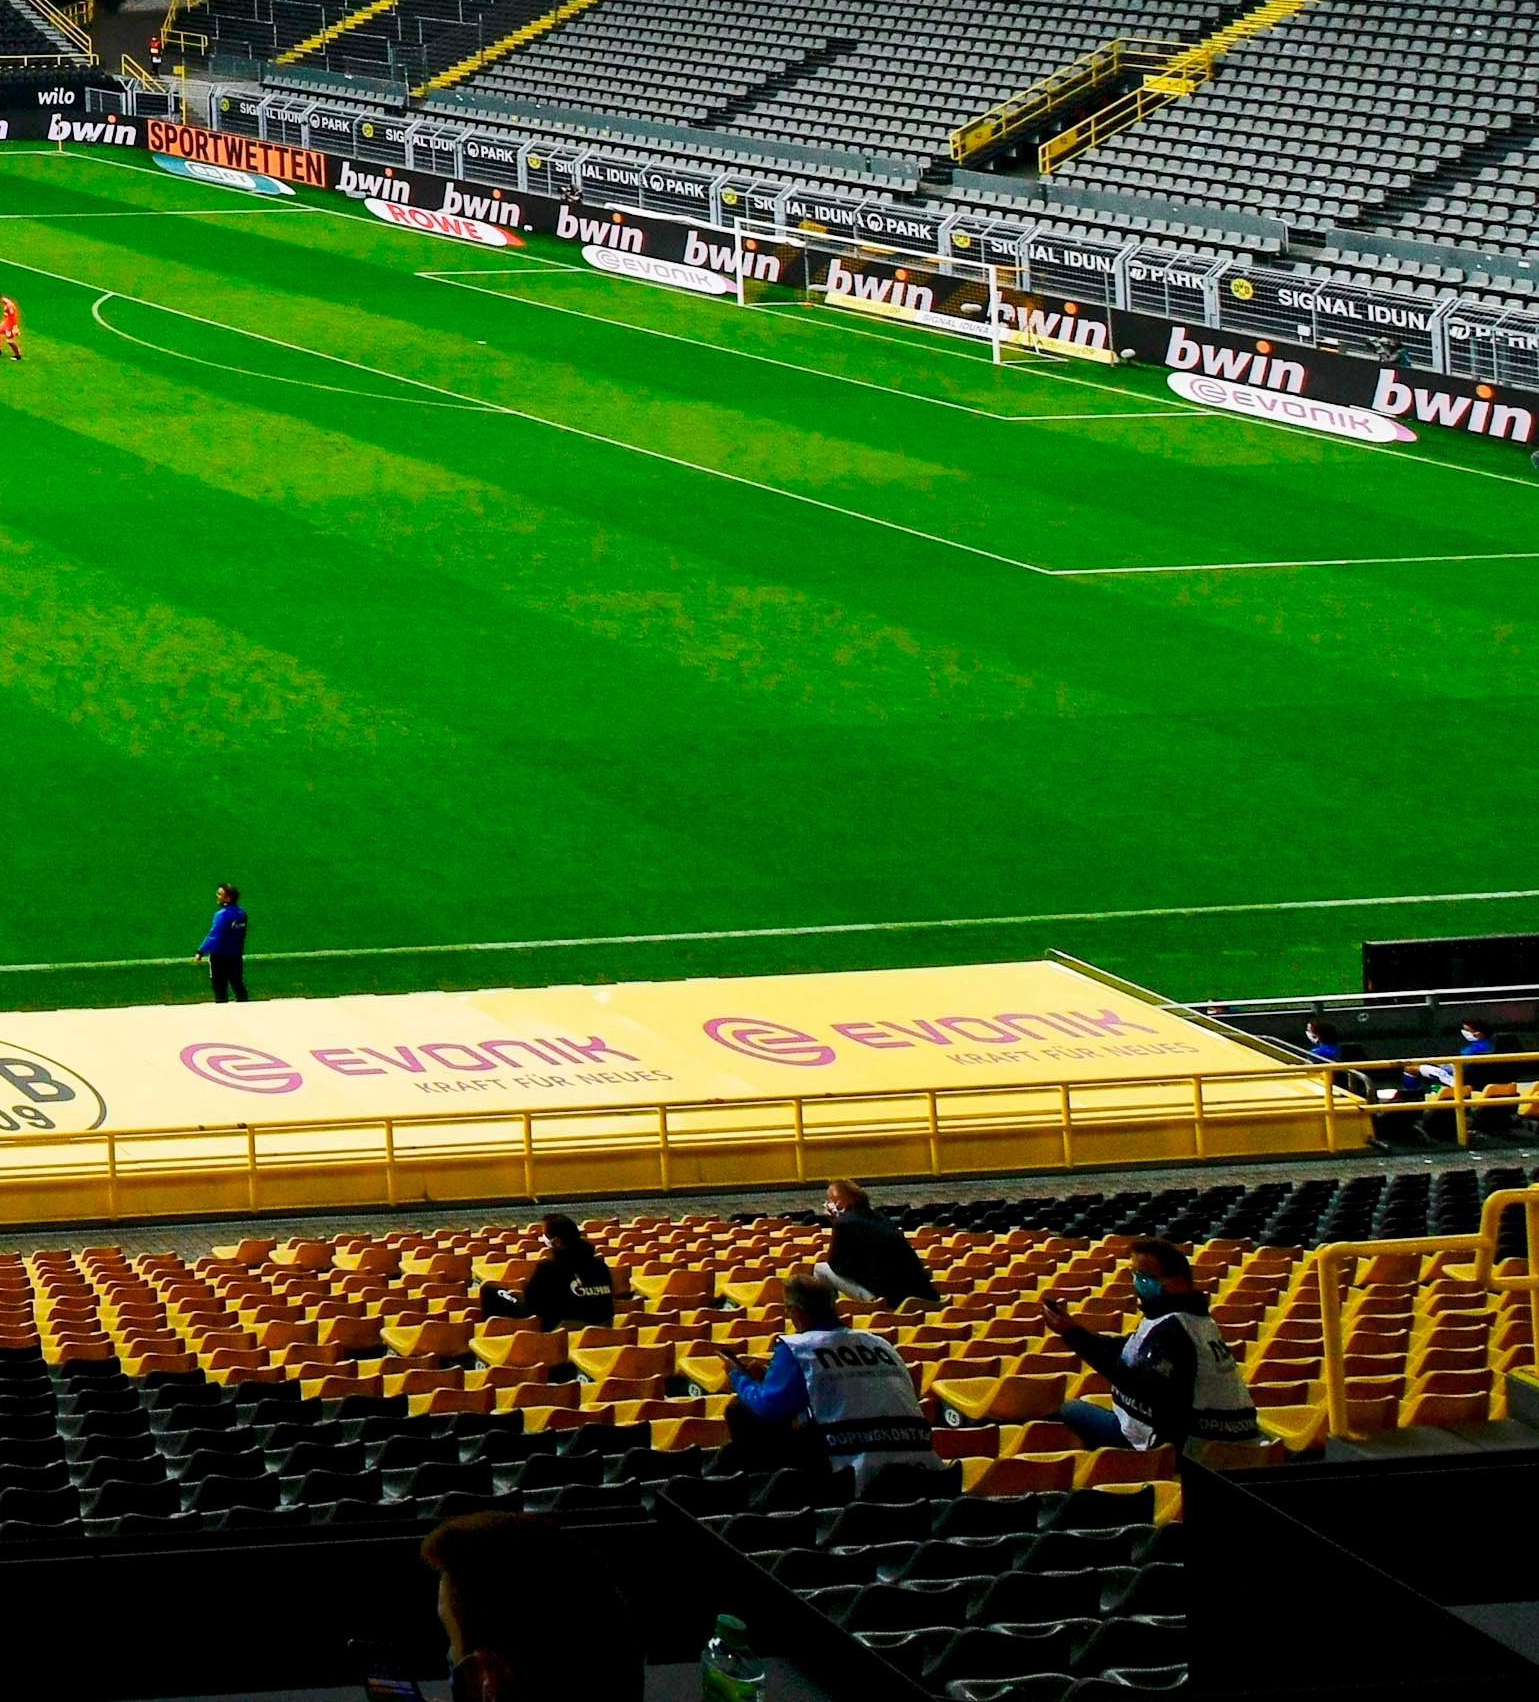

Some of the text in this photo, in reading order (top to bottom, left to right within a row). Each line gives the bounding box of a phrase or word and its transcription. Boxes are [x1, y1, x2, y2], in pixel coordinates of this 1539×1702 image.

[38, 87, 75, 105] wilo
[47, 114, 136, 146] bwin
[149, 121, 324, 185] SPORTWETTEN
[339, 162, 411, 206] bwin
[390, 202, 484, 241] ROWE
[443, 188, 520, 228] bwin
[557, 204, 643, 253] bwin
[1165, 326, 1310, 394] bwin
[1232, 389, 1374, 434] EVONIK
[1372, 368, 1536, 444] bwin
[831, 1007, 1159, 1054] EVONIK
[310, 1034, 641, 1079] EVONIK
[946, 1043, 1202, 1074] KRAFT FÜR NEUES
[414, 1065, 676, 1097] KRAFT FÜR NEUES
